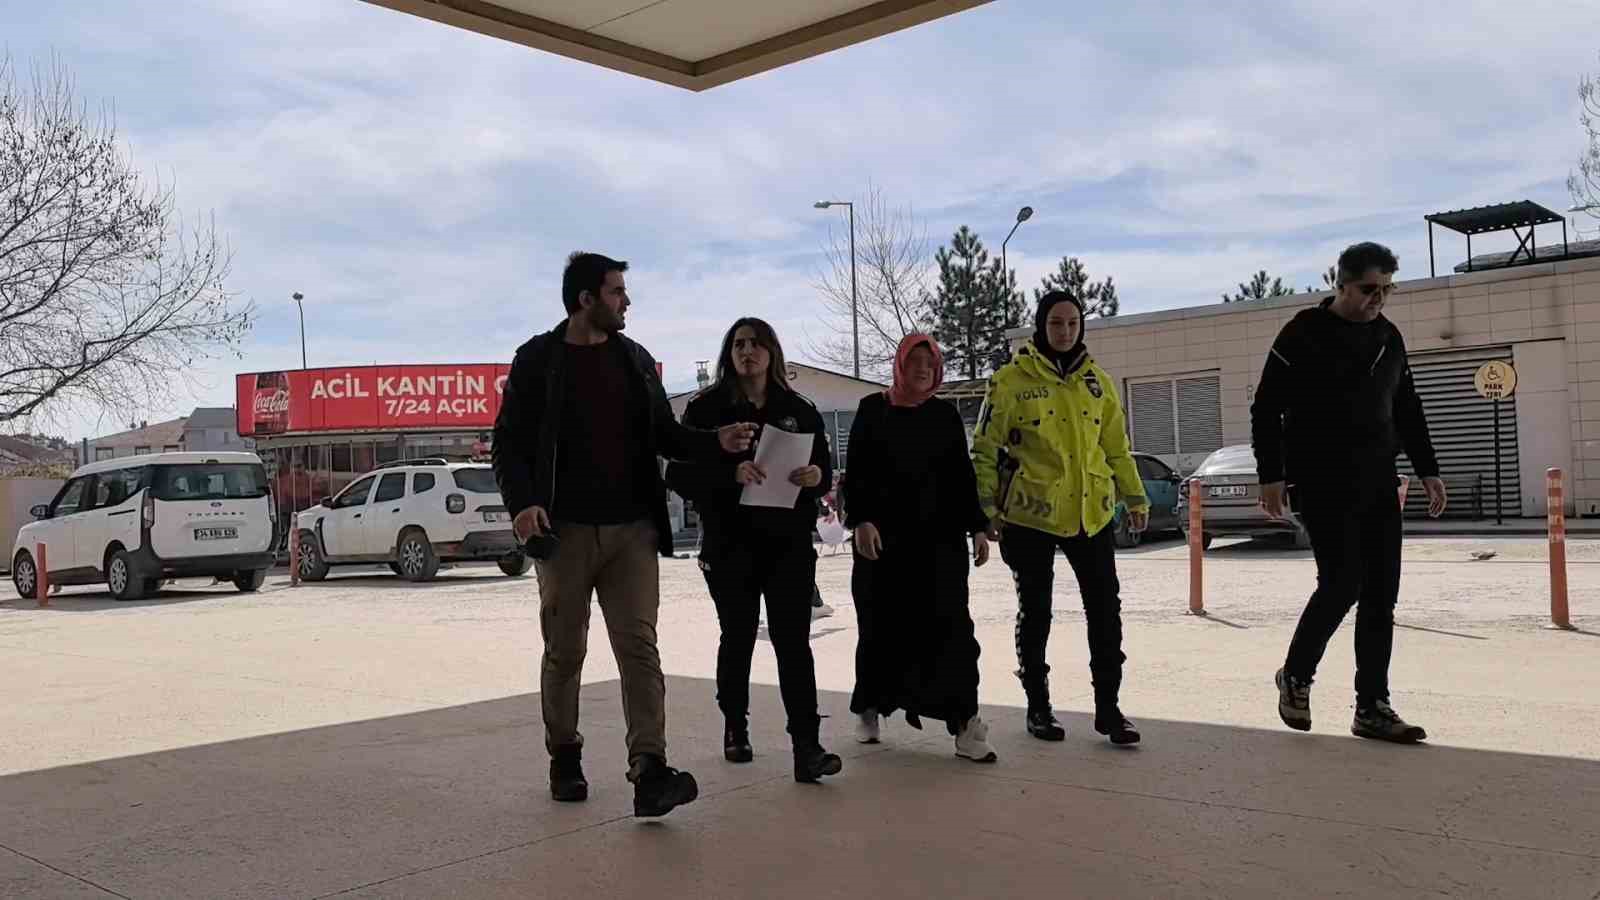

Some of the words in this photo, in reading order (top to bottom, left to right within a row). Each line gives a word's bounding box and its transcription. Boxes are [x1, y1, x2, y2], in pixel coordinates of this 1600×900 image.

[311, 373, 369, 399] ACİL
[377, 370, 485, 396] KANTİN
[385, 399, 430, 416] 7/24
[436, 398, 488, 417] AÇIK
